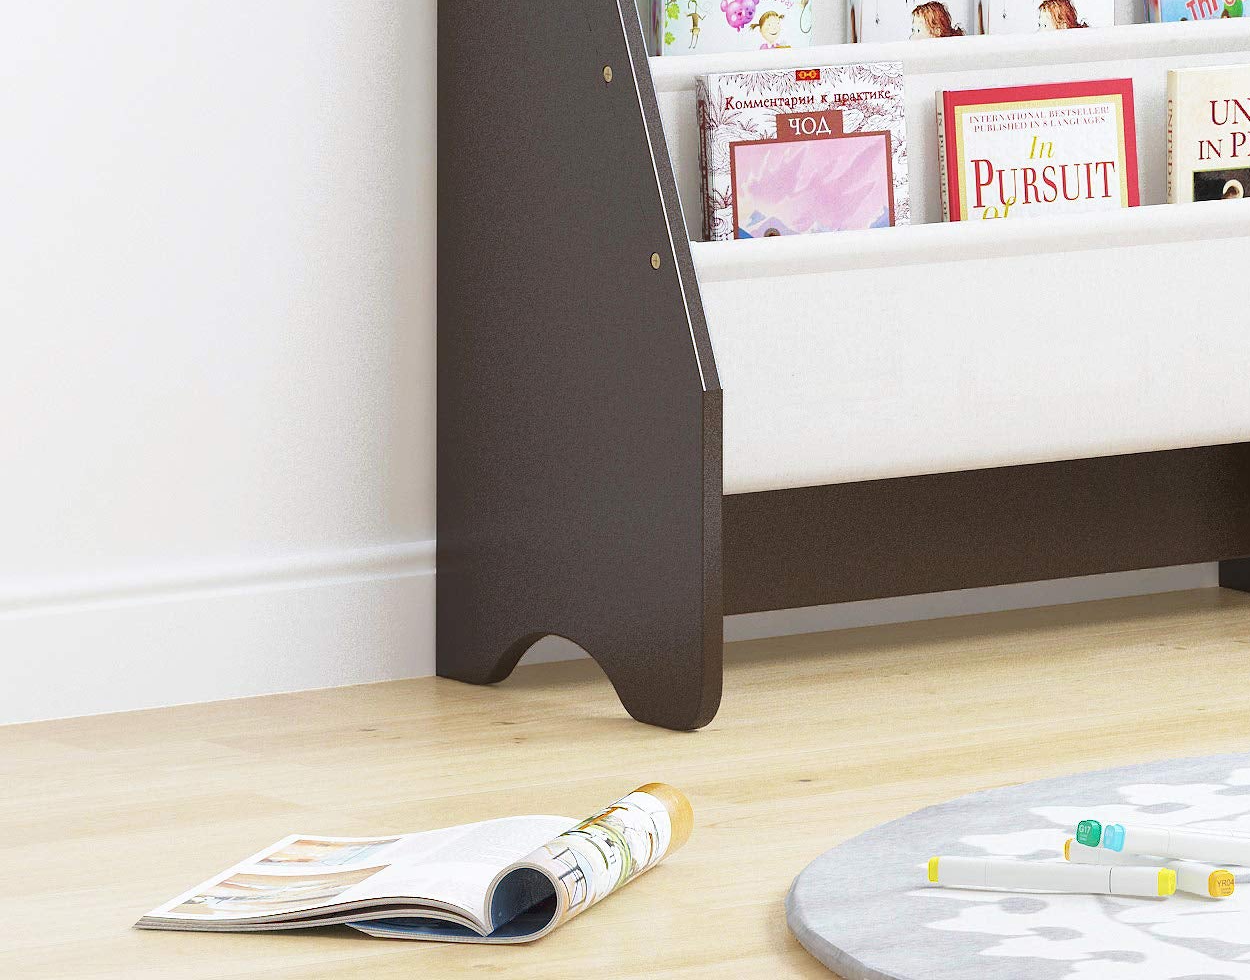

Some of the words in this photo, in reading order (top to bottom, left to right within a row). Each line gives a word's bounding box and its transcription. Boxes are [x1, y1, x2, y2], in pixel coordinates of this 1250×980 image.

[724, 95, 815, 111] Комментарии
[820, 94, 828, 103] к
[833, 89, 893, 107] практике
[969, 110, 1046, 124] INTERNATIONAL
[1049, 106, 1110, 118] BESTSELLER!
[974, 121, 1027, 133] PUBLISHED
[1030, 120, 1041, 129] IN
[1050, 116, 1106, 128] LANGUAGES
[788, 116, 832, 136] ЧОД
[1029, 135, 1055, 160] In
[1198, 139, 1223, 160] IN
[970, 158, 1116, 209] PURSUIT
